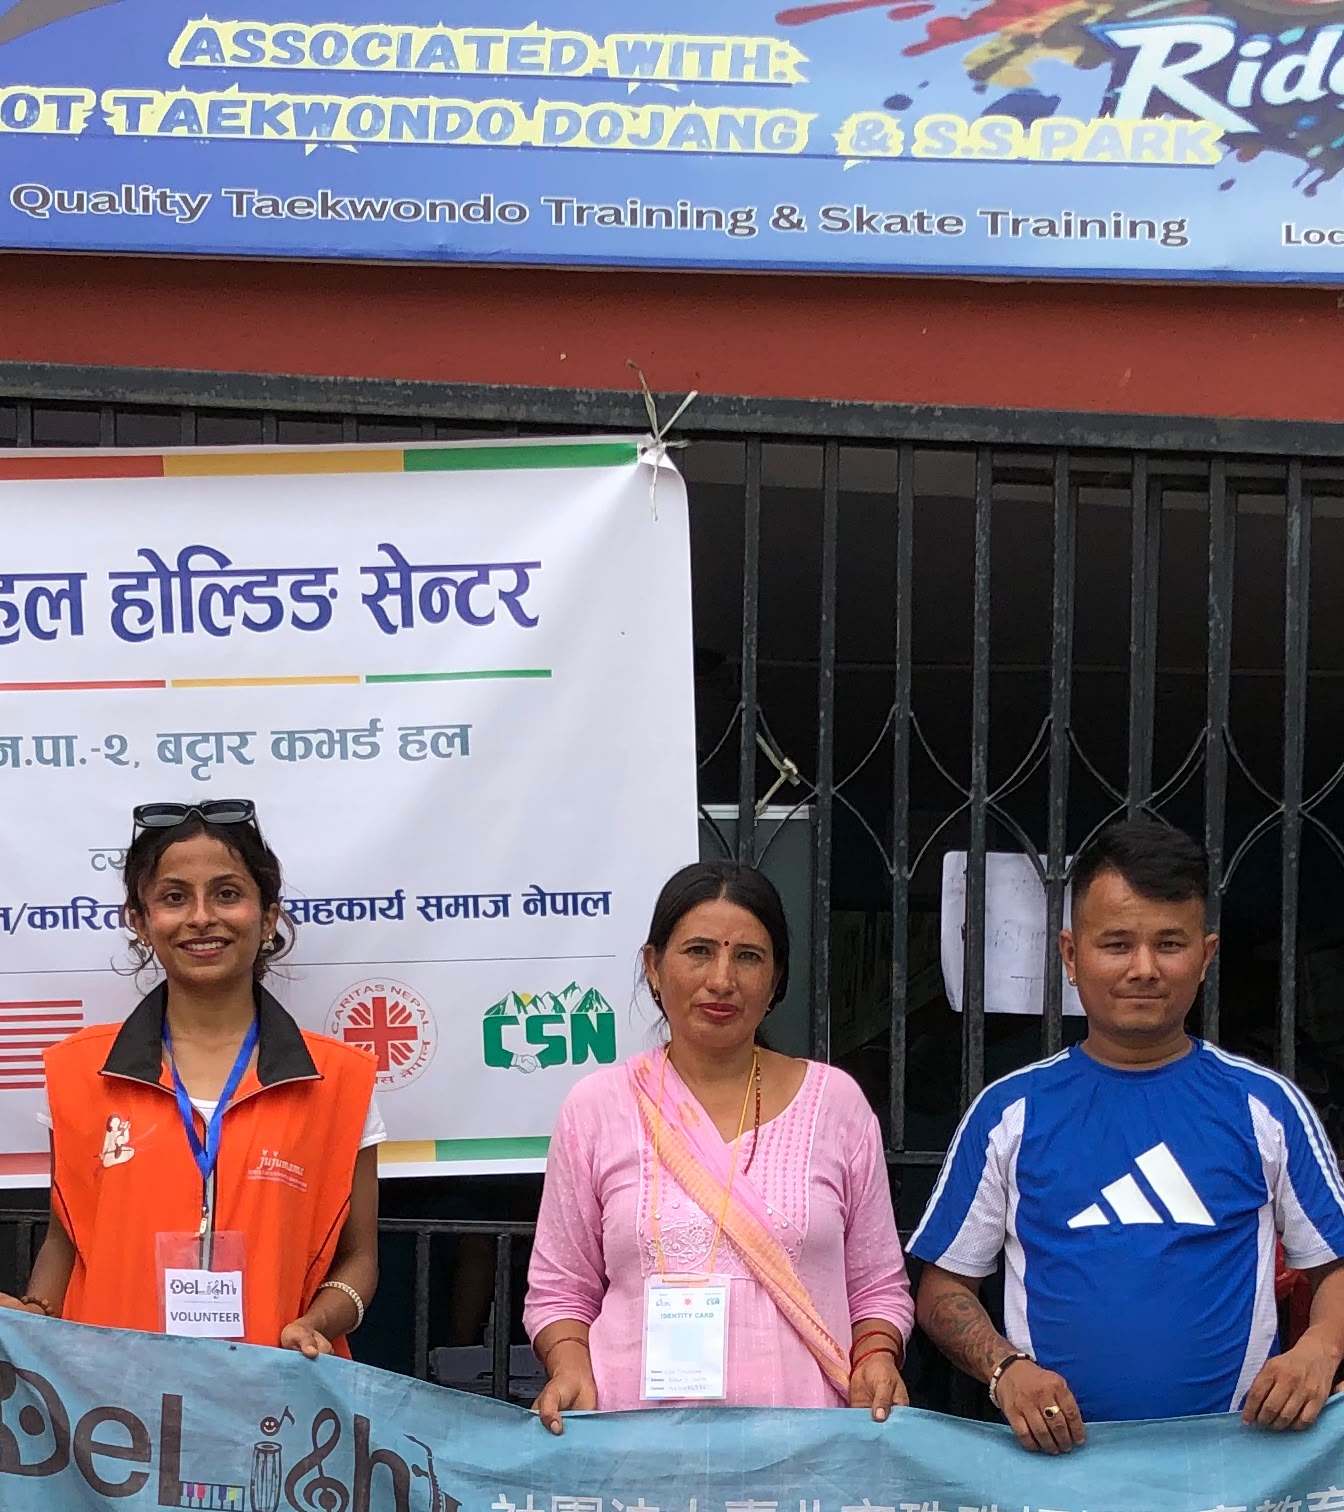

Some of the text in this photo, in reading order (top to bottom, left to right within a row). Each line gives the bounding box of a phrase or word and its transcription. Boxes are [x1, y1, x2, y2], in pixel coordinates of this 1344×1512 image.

[177, 22, 592, 76] ASSOCIATED
[113, 91, 518, 146] TAEKWONDO
[542, 105, 798, 153] DOJANG
[849, 117, 892, 156] &
[1038, 122, 1215, 162] PARK
[9, 184, 211, 224] Quality
[223, 187, 530, 225] Taekwondo
[542, 195, 759, 238] Training
[770, 203, 807, 234] &
[818, 206, 965, 238] Skate
[979, 209, 1190, 248] Training
[107, 545, 340, 638] होल्डिङ
[359, 542, 543, 634] सेन्टर
[269, 717, 384, 762] कभर्ड
[397, 724, 473, 762] हल
[416, 893, 512, 923] समाज
[521, 884, 612, 917] नेपाल
[331, 983, 432, 1035] CARITAS NEPAL
[482, 1012, 617, 1070] CSN
[170, 1310, 241, 1324] VOLUNTEER
[660, 1312, 693, 1320] IDENTITY
